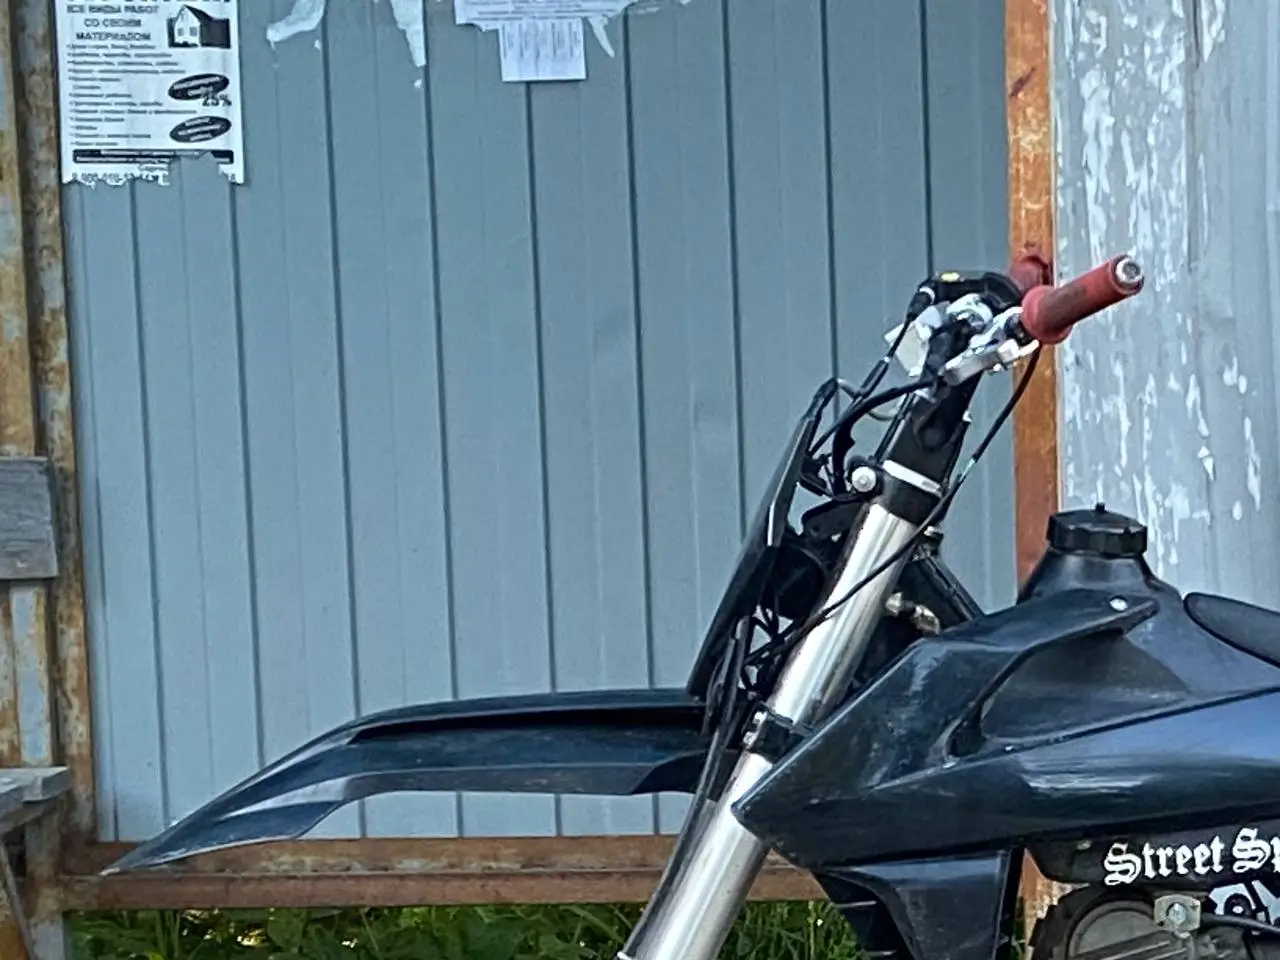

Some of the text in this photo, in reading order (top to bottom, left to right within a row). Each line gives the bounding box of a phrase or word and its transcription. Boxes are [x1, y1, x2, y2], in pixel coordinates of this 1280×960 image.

[83, 18, 100, 28] СО
[76, 32, 152, 41] МАТЕРИАЛОМ
[1103, 835, 1226, 887] Street
